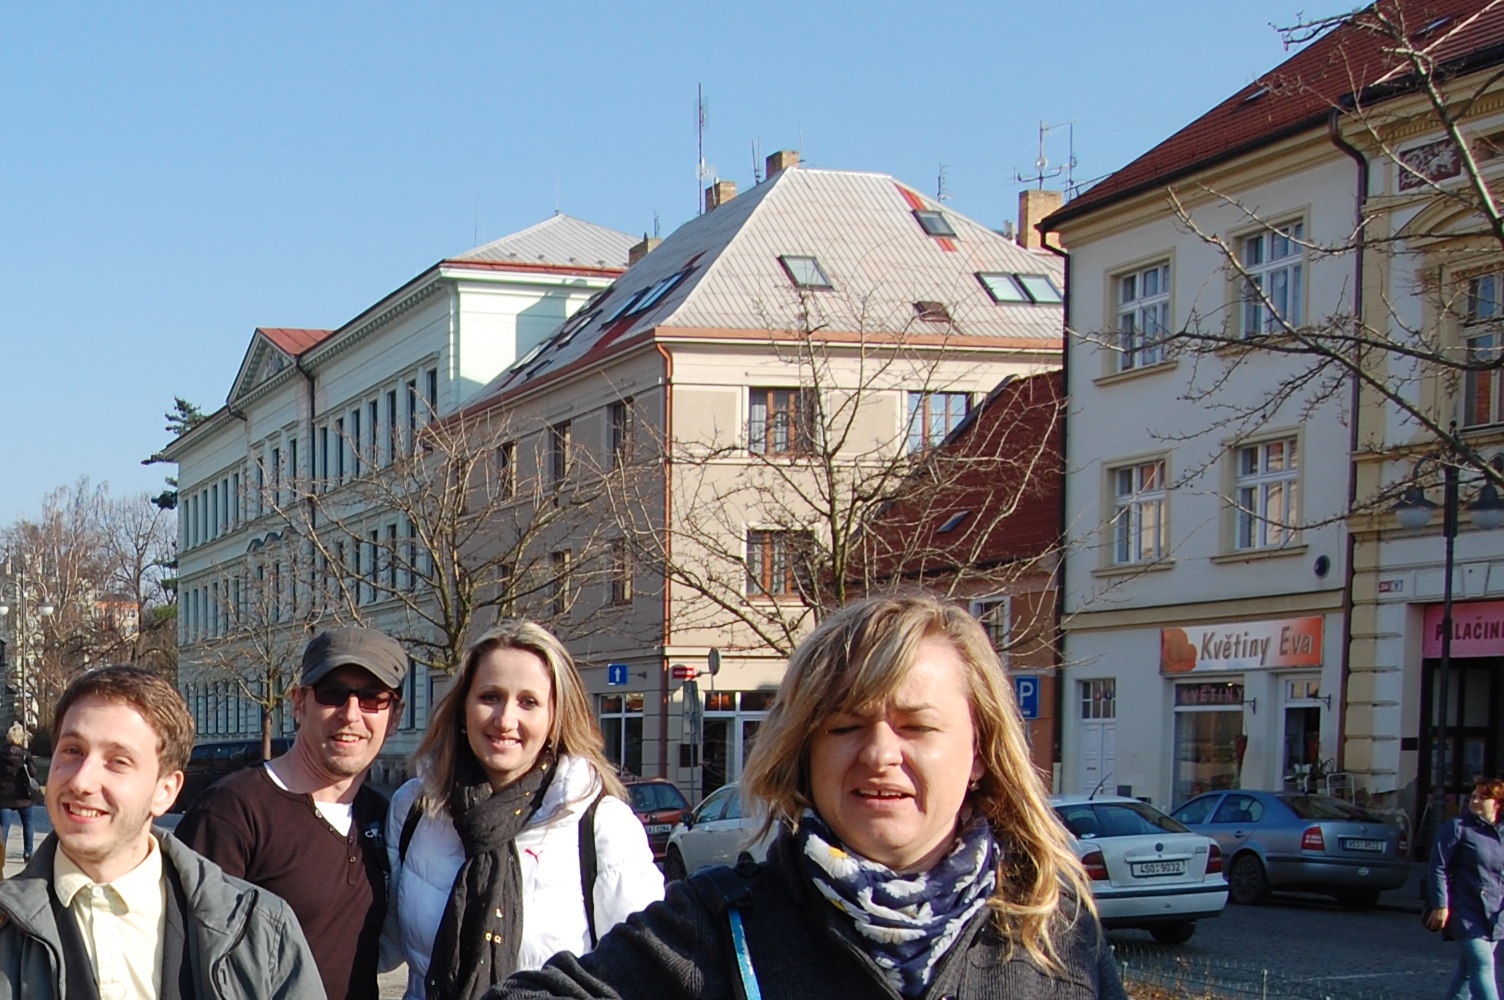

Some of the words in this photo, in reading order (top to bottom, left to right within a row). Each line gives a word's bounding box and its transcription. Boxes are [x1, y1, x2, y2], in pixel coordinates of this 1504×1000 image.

[1436, 616, 1504, 641] PLAČIN
[1200, 632, 1270, 666] Květiny
[1279, 626, 1313, 656] Eva
[1019, 681, 1034, 706] P
